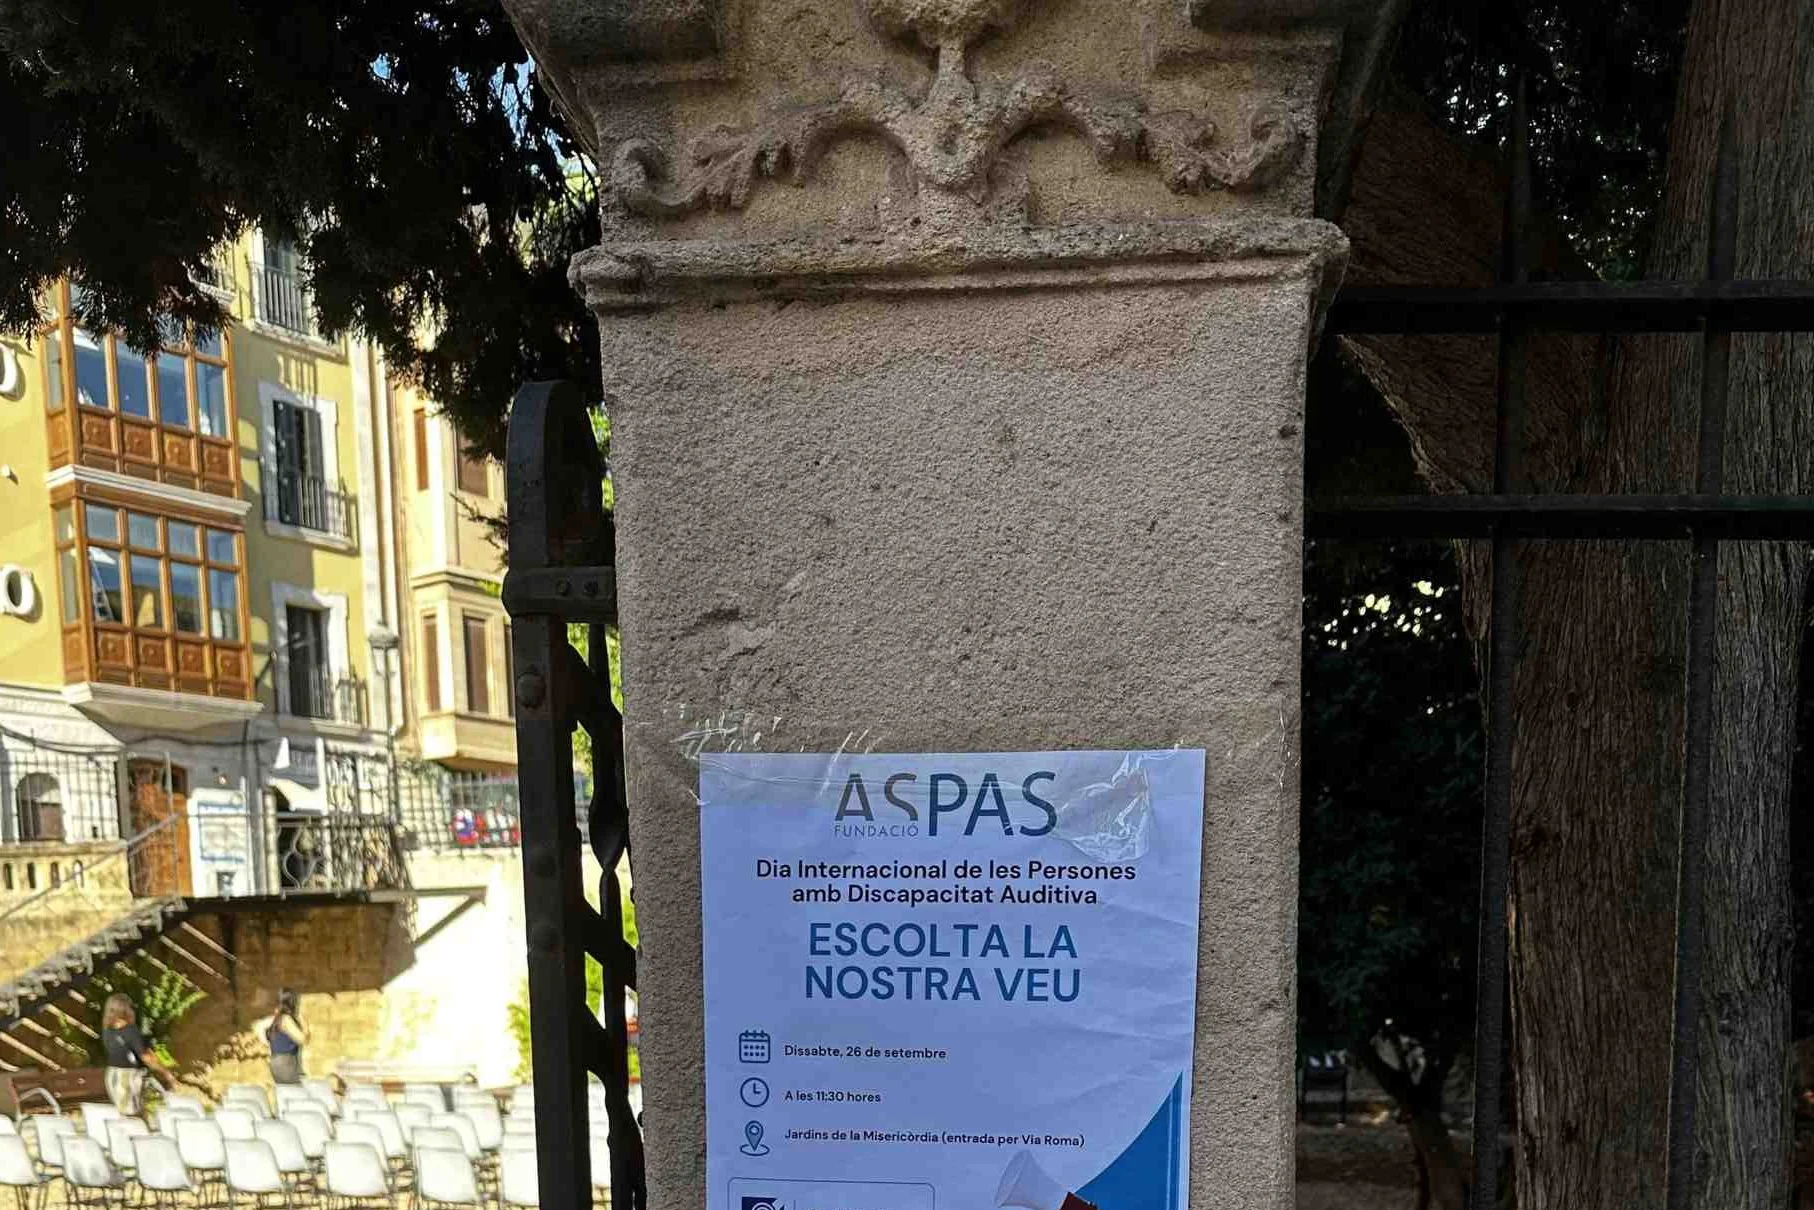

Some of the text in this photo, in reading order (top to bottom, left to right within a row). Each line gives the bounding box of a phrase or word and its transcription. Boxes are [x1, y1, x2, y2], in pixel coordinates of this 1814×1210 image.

[835, 772, 1057, 837] ASPAS
[834, 821, 918, 837] FUNDACIÓ
[757, 859, 1136, 880] Dia Internacional de les Persones
[792, 884, 1097, 908] amb Discapacitat Auditiva
[809, 922, 1078, 958] ESCOLTA LA
[806, 966, 1081, 1002] NOSTRA VEU
[784, 1045, 946, 1059] Dissabte, 26 de setembre
[785, 1091, 881, 1102] A les 11:30 hores
[784, 1129, 1085, 1147] Jardins de la Misericòrdia (entrada per Via Roma)
